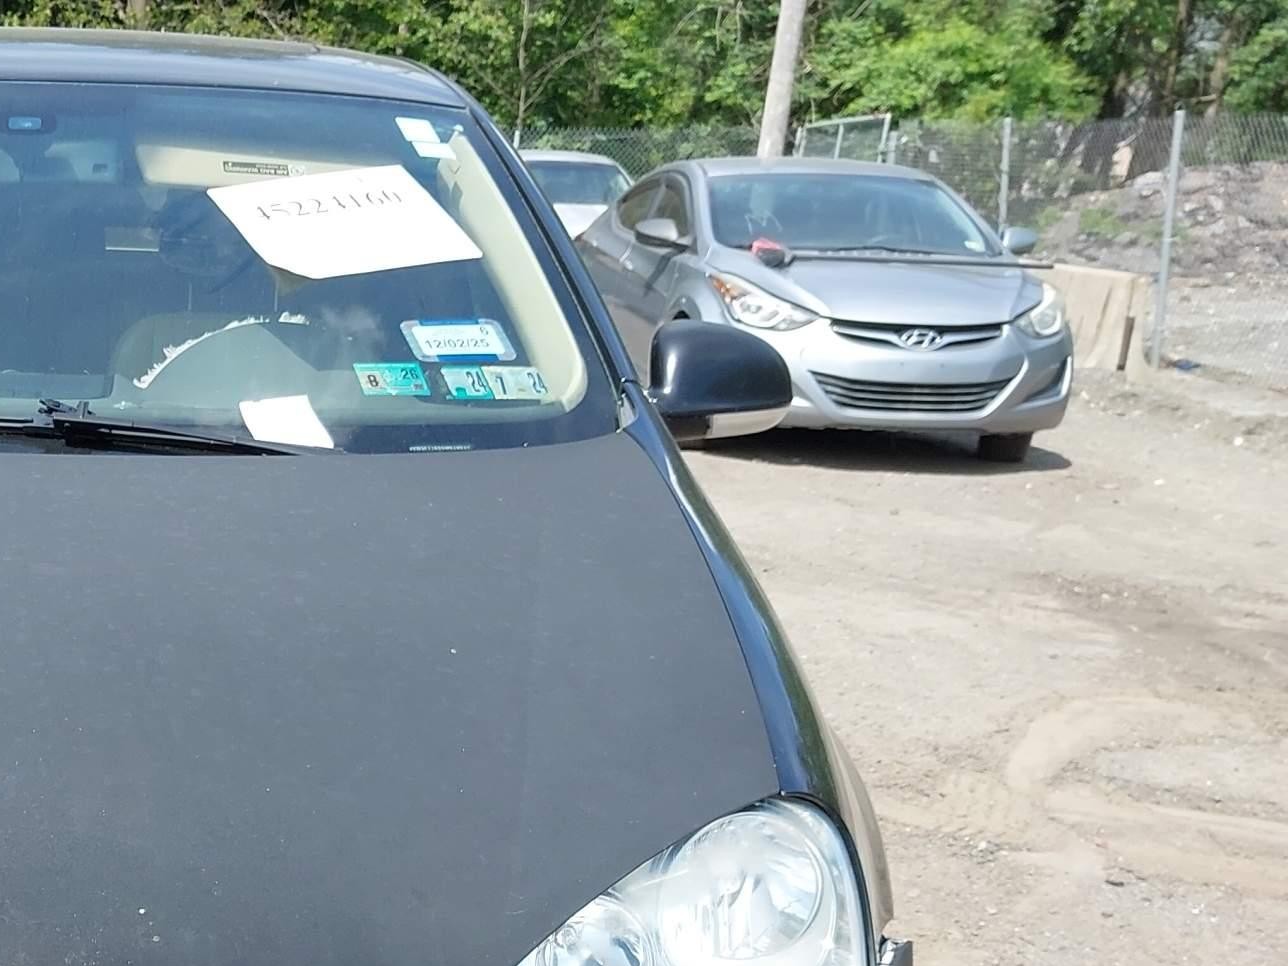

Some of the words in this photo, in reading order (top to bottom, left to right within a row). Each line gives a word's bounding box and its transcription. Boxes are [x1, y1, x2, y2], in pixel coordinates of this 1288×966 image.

[424, 336, 491, 350] 12/02/25
[465, 370, 489, 393] 24
[526, 371, 550, 394] 24
